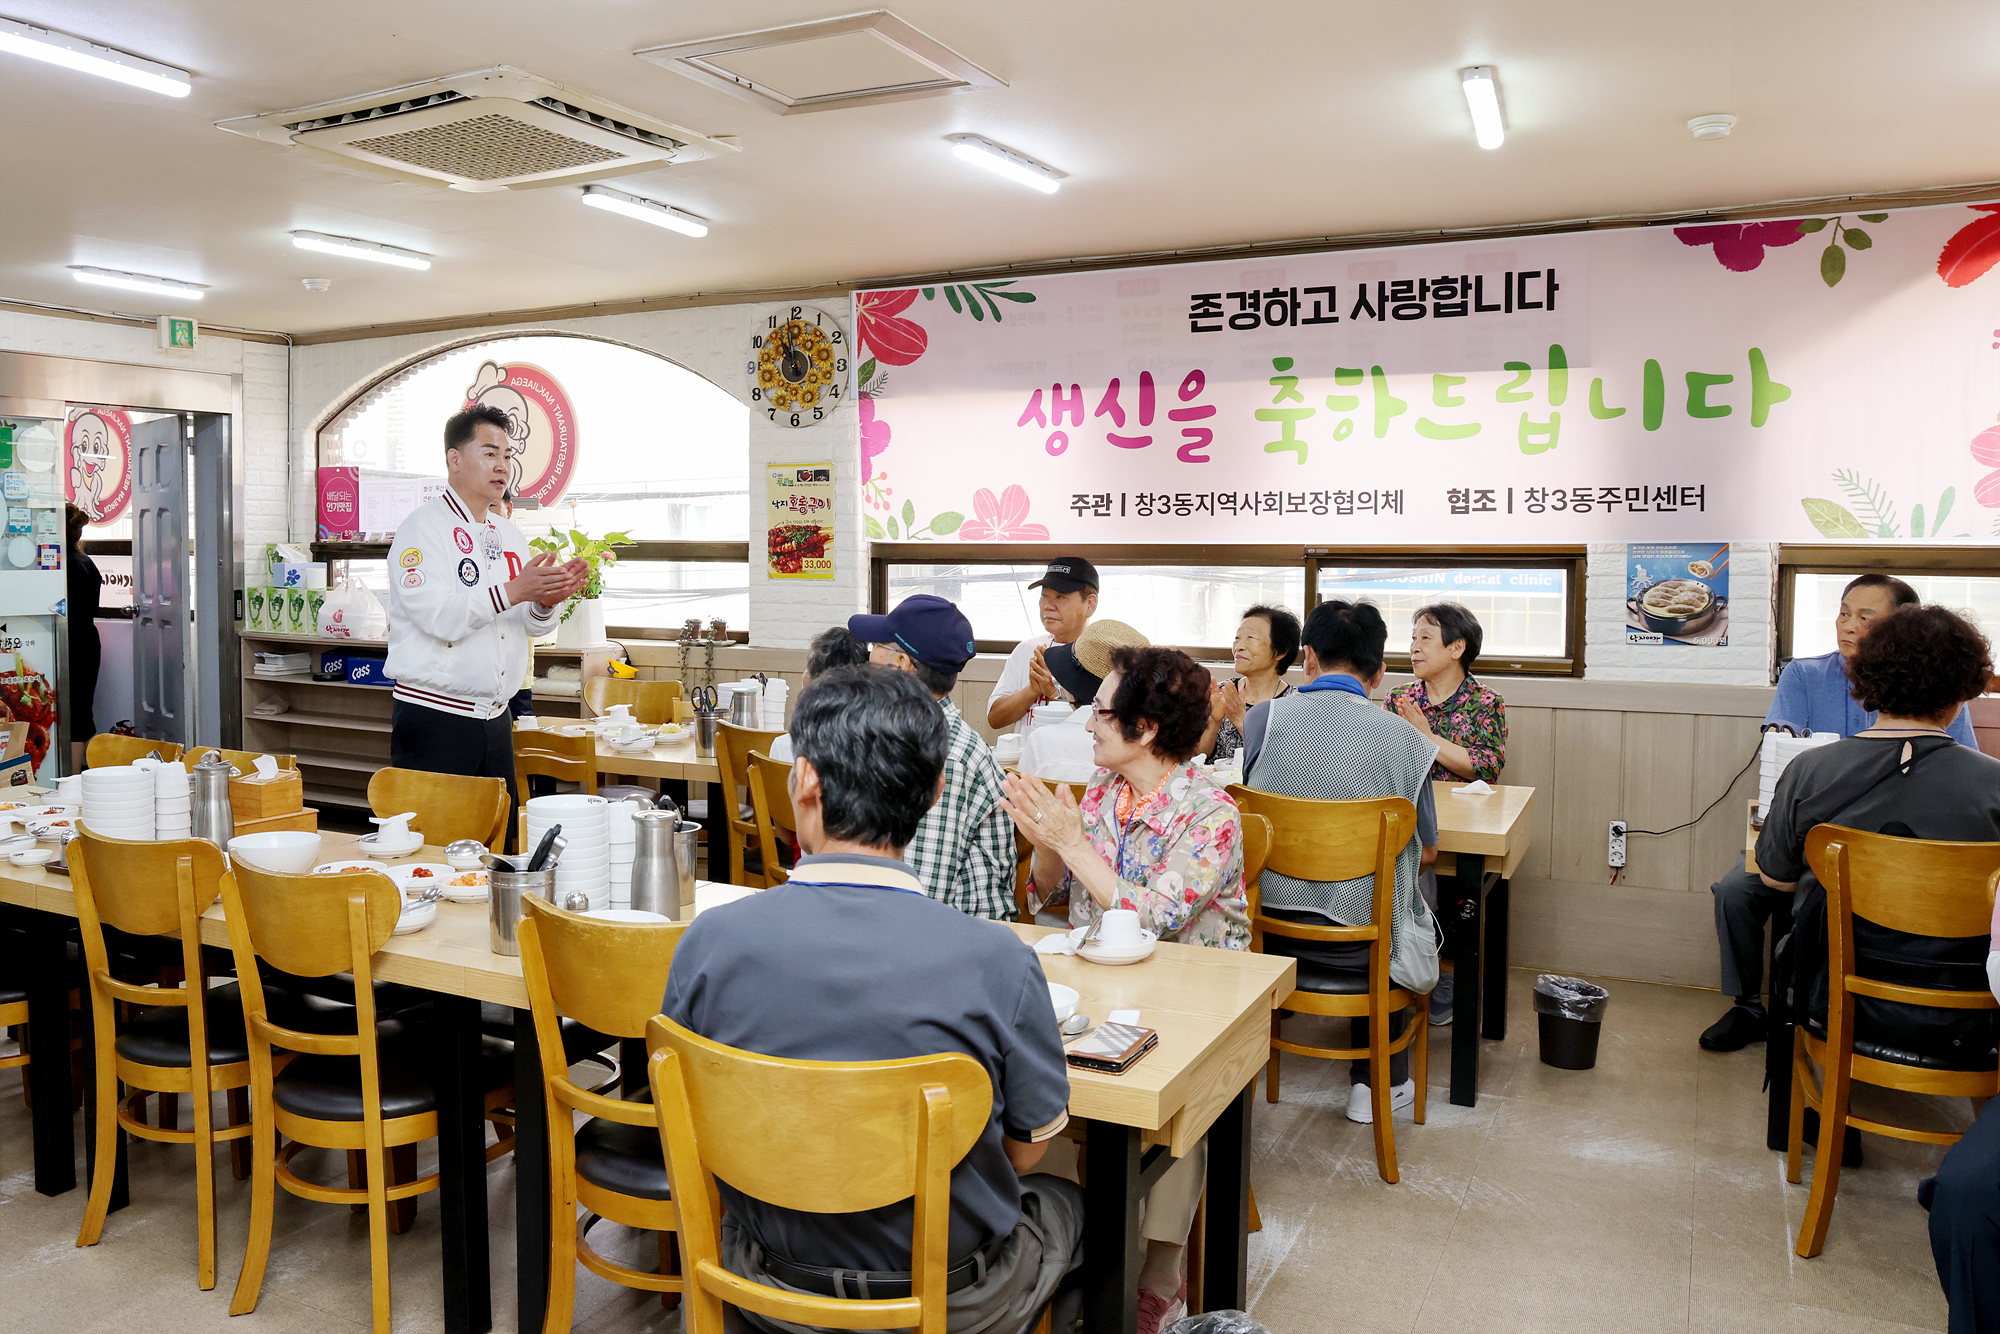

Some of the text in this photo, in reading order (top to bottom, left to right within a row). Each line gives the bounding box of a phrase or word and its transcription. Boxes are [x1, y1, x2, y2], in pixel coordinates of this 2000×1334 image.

[1189, 268, 1559, 332] 존경하고 사랑합니다
[791, 306, 802, 320] 12
[817, 312, 821, 326] 1
[769, 315, 777, 328] 11
[753, 335, 762, 349] 10
[831, 331, 842, 344] 2
[747, 361, 756, 374] 9
[837, 358, 847, 372] 3
[752, 387, 761, 401] 8
[829, 384, 840, 398] 4
[1017, 343, 1792, 465] 생신을 축하드립니다
[768, 408, 776, 420] 7
[790, 413, 800, 427] 6
[813, 406, 824, 420] 5
[326, 491, 352, 502] 배달되는
[1070, 492, 1113, 517] 주관
[1135, 489, 1404, 517] 창3동지역사회보장협의체
[1447, 488, 1497, 515] 협조
[1524, 484, 1705, 513] 창3동주민센터
[326, 502, 352, 513] 인기맛집
[772, 494, 831, 515] 낙지 호롱구이
[804, 560, 832, 570] 33,000
[1454, 571, 1502, 585] dental
[1510, 573, 1552, 586] clinic
[324, 659, 343, 673] Cass
[352, 664, 371, 680] Cass
